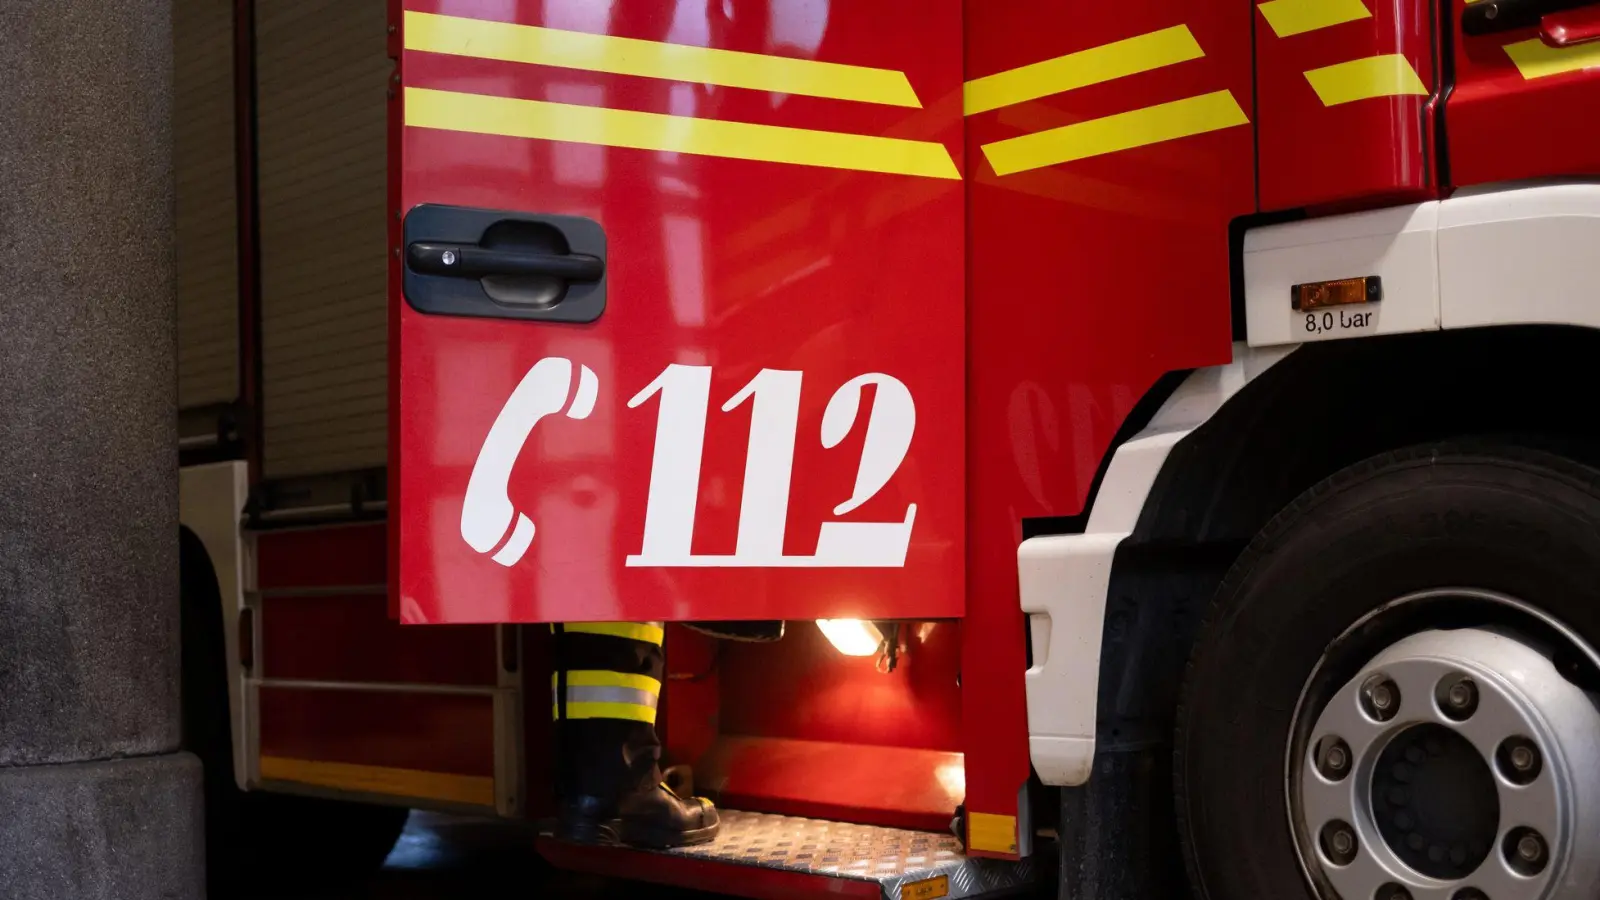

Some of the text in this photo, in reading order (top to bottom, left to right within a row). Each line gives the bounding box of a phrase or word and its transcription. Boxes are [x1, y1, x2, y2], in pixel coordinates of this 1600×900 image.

[1305, 310, 1372, 334] 8,0 bar
[625, 363, 917, 568] 112
